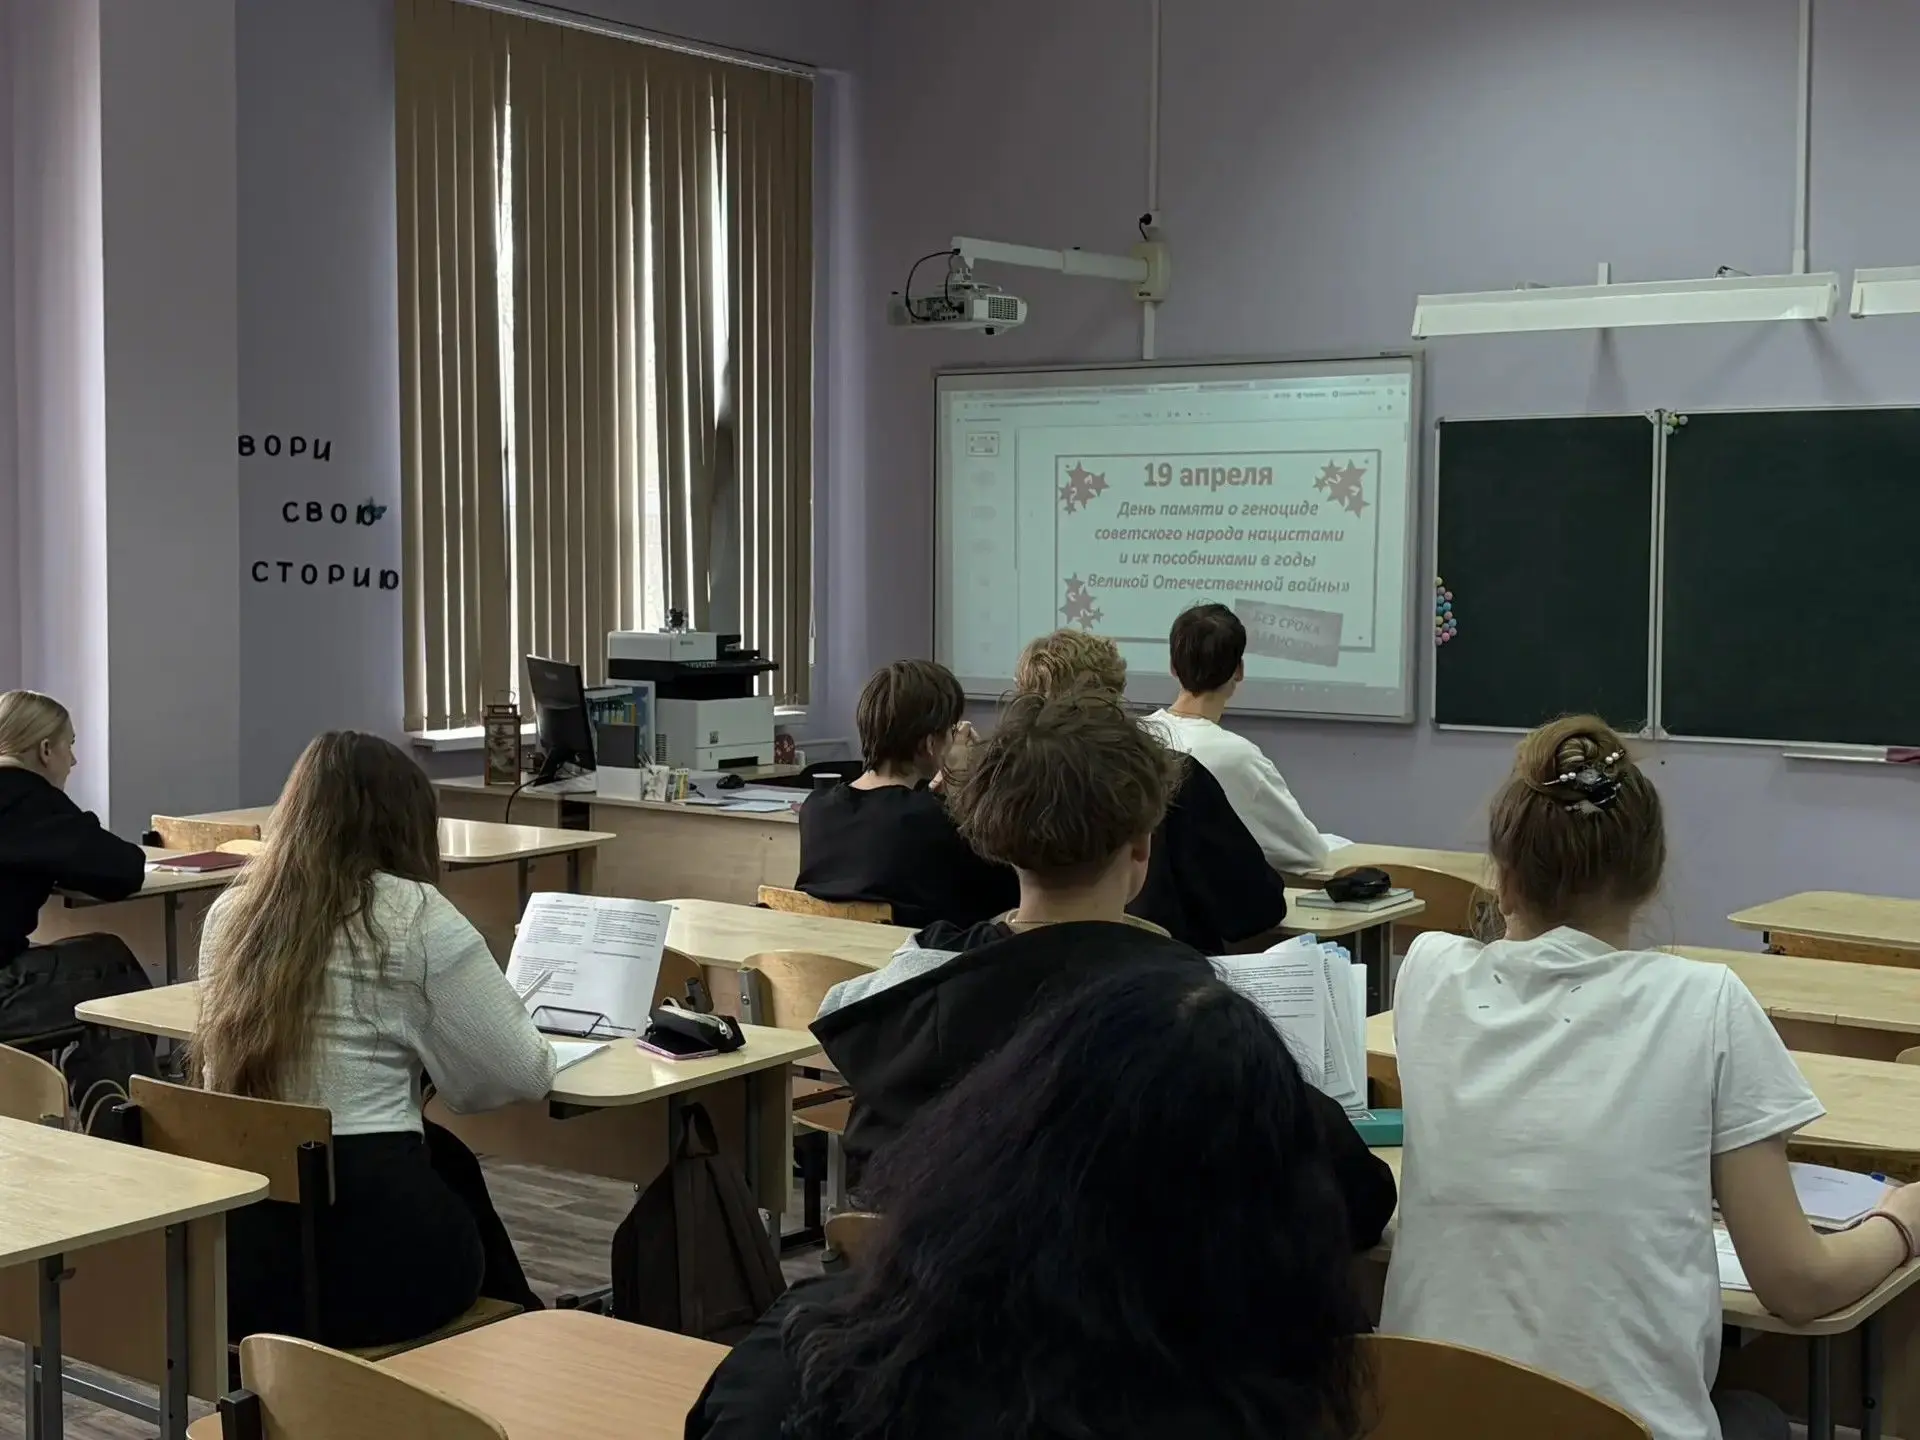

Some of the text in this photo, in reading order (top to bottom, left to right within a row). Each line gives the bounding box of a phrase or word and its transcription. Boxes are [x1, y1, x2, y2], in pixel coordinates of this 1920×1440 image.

[1143, 463, 1273, 491] 19 апреля
[282, 501, 376, 526] СВОЮ
[1117, 501, 1319, 518] День памяти о геноциде
[1094, 526, 1344, 543] советского народа нацистами
[1119, 550, 1316, 568] и их пособниками в годы
[1087, 573, 1350, 593] Великой Отечественной войны»
[1252, 609, 1321, 636] БЕЗ СРОКА
